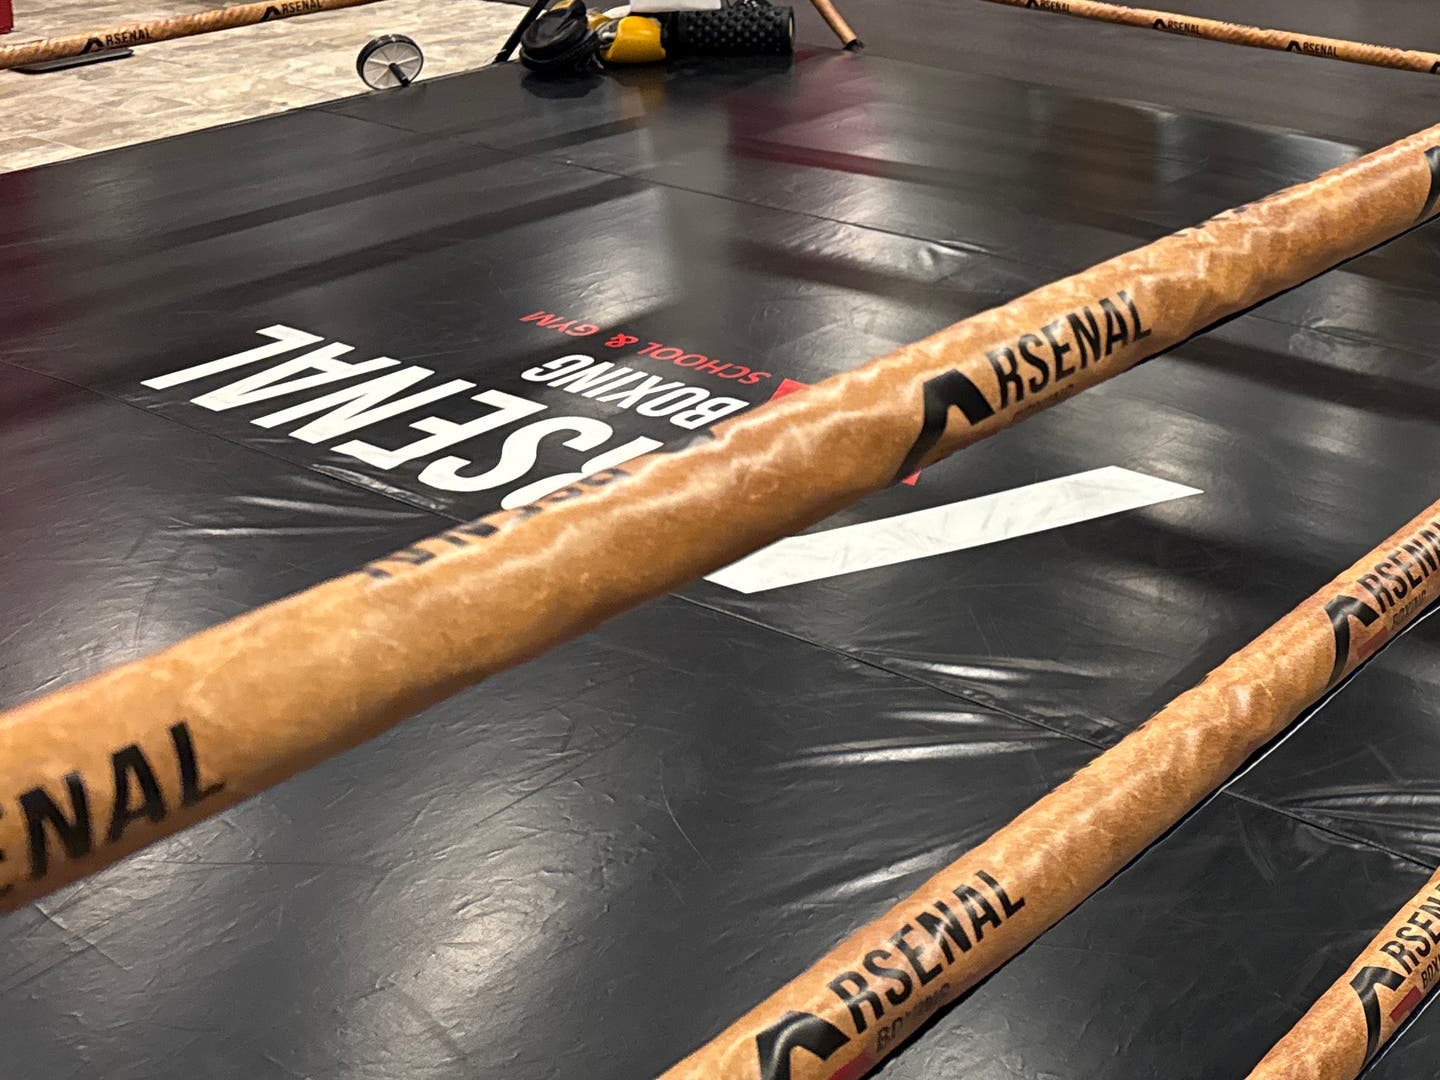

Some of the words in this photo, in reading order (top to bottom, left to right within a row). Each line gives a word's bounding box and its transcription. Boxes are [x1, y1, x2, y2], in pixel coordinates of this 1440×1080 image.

[79, 29, 153, 55] ARSENAL
[1152, 18, 1201, 36] ARSENAL
[1286, 40, 1338, 58] ARSENAL
[519, 310, 600, 337] GYM
[638, 341, 771, 385] SCHOOL
[520, 354, 750, 430] BOXING
[891, 289, 1152, 482] ARSENAL
[756, 869, 1026, 1080] ARSENAL
